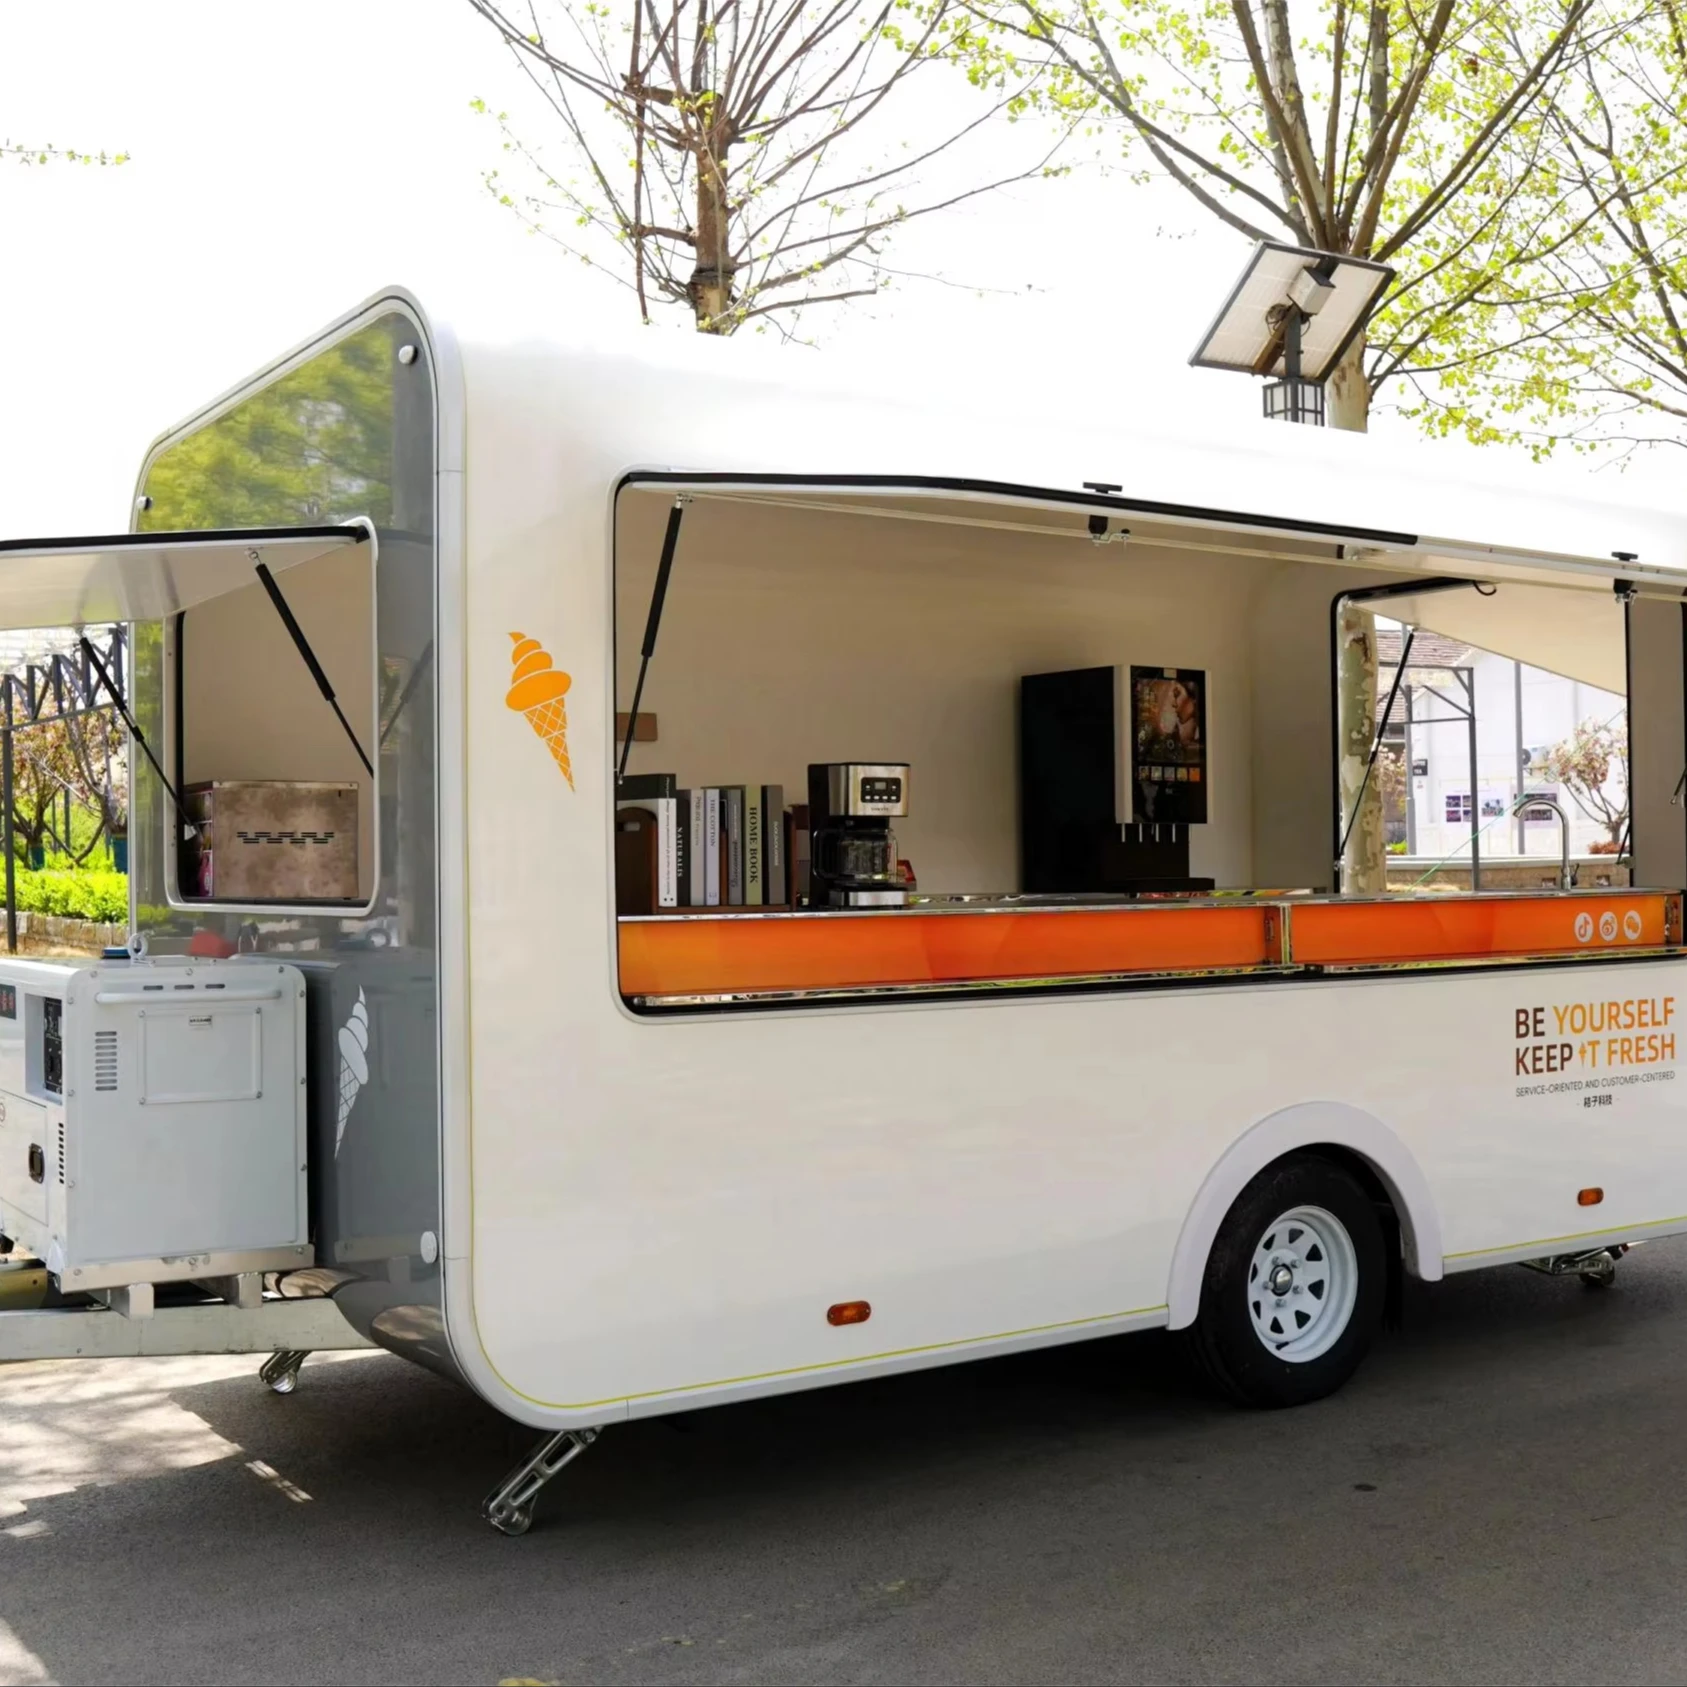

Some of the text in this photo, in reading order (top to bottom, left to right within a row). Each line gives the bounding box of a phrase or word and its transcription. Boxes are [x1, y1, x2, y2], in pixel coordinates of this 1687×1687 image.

[749, 806, 758, 883] HOME BOOK
[1515, 997, 1675, 1039] BE YOURSELF
[1515, 1043, 1573, 1076] KEEP
[1607, 1033, 1675, 1066] FRESH
[1515, 1070, 1676, 1097] SERVICE-ORIENTED AND CUSTOMER-CENTERED
